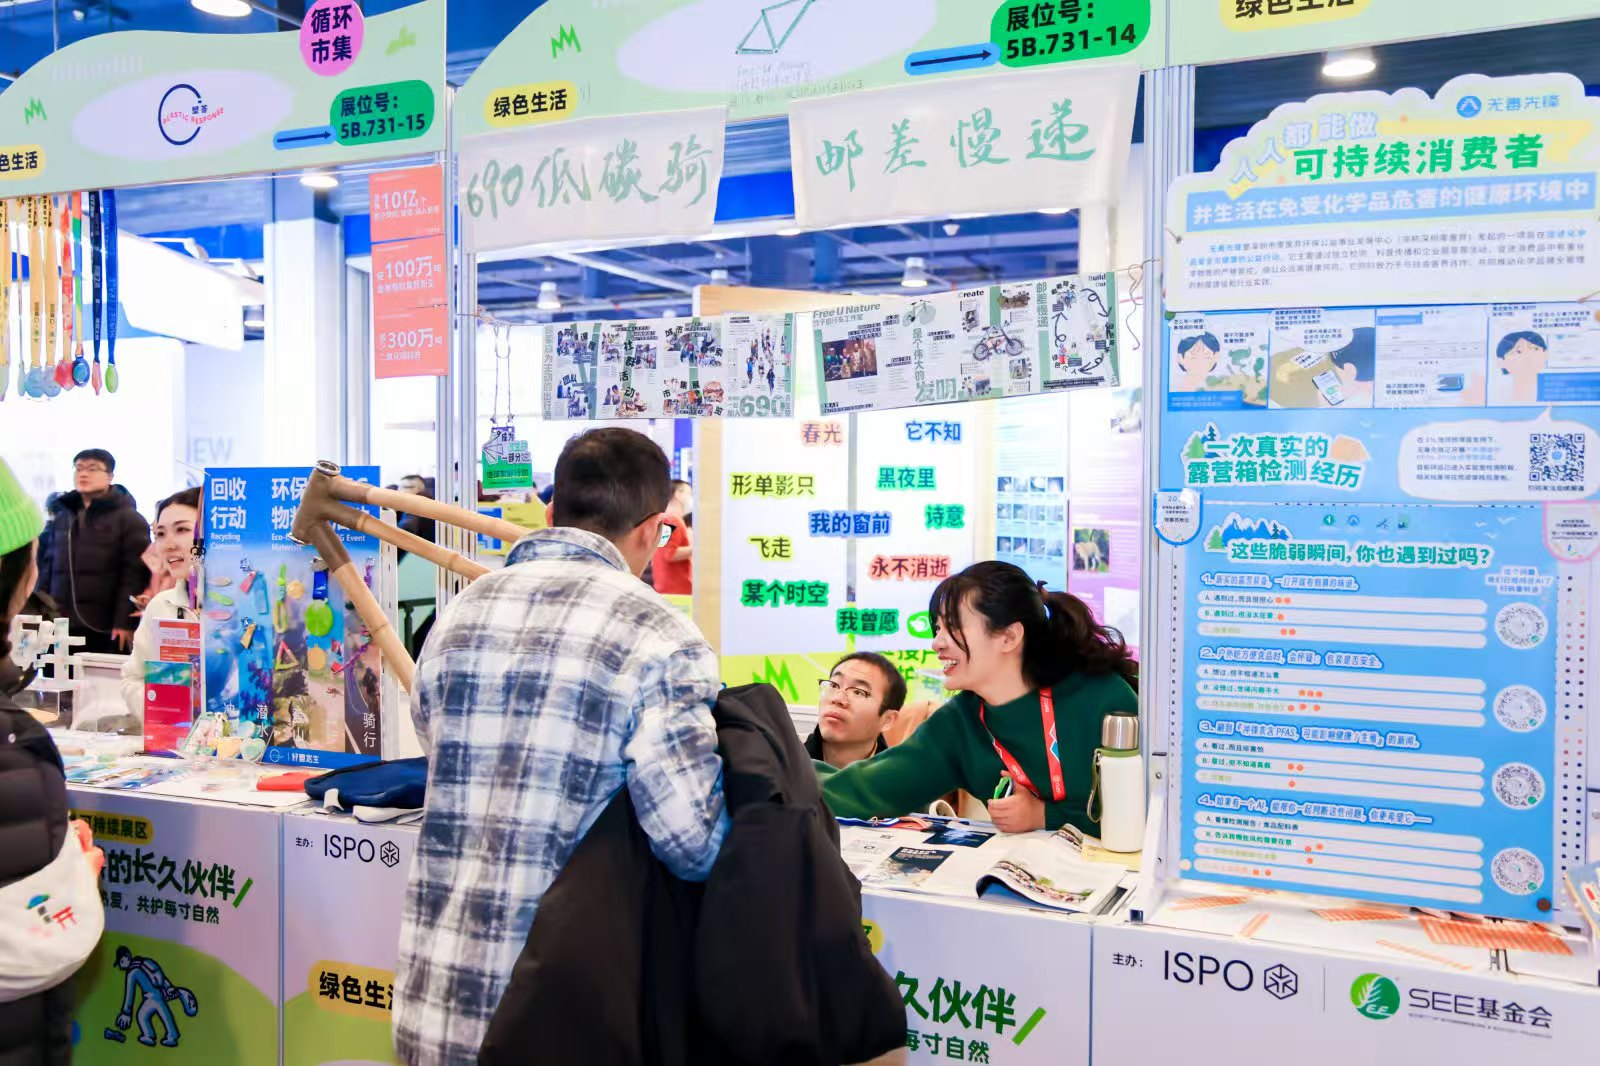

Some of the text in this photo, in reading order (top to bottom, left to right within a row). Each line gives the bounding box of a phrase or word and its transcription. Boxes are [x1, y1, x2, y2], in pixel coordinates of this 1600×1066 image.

[310, 5, 353, 35] 循环
[1235, 0, 1355, 19] 绿色
[310, 36, 353, 64] 市集
[1006, 23, 1137, 60] 5B.731-14
[340, 91, 399, 119] 展位号：
[493, 88, 568, 119] 绿色生活
[340, 114, 427, 140] 5B.731-15
[815, 97, 1097, 193] 邮差慢递
[1292, 132, 1544, 182] 可持续消费者
[1192, 178, 1591, 226] 并生活在免受化学品危害的健康环境中
[812, 309, 835, 319] Free
[845, 302, 881, 315] Nature
[914, 377, 957, 403] 发明
[803, 423, 842, 445] 春光
[905, 421, 962, 442] 它不知
[1206, 434, 1329, 459] 一次真实的
[732, 474, 815, 496] 形单影只
[878, 466, 936, 489] 黑夜里
[1187, 458, 1363, 489] 露营箱检测经历
[210, 477, 247, 501] 回收
[210, 506, 247, 530] 行动
[810, 512, 891, 535] 我的窗前
[925, 505, 965, 530] 诗意
[210, 533, 241, 542] Recycling
[346, 534, 366, 543] Event
[750, 536, 791, 559] 飞走
[871, 557, 949, 579] 永不消逝
[744, 582, 827, 605] 某个时空
[838, 609, 898, 633] 我曾愿
[256, 704, 270, 738] 潜水
[363, 712, 378, 749] 骑行
[70, 811, 148, 840] 可持续展区
[324, 834, 375, 863] ISPO
[101, 847, 236, 901] 的长久伙伴
[1112, 953, 1144, 968] 主办：
[1164, 950, 1254, 992] ISPO
[1408, 987, 1553, 1029] SEE基金会
